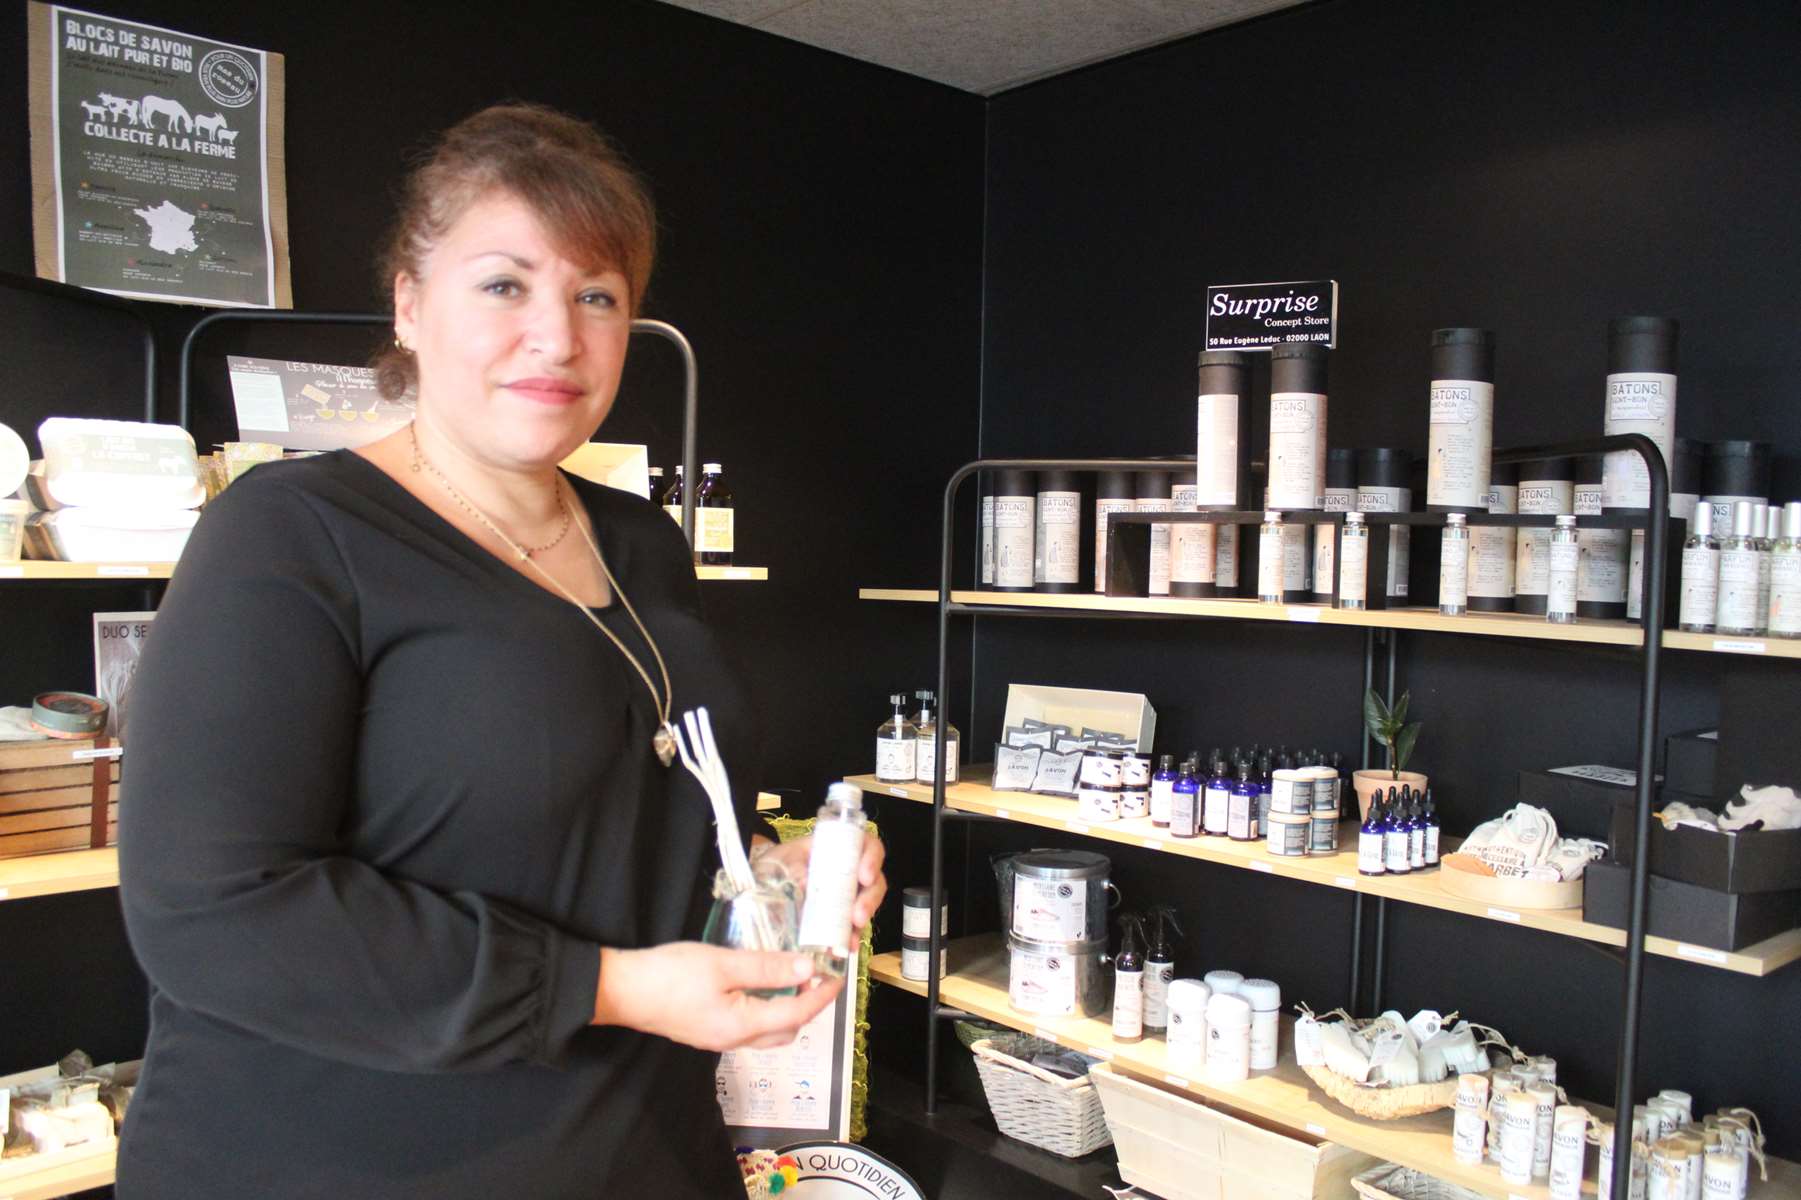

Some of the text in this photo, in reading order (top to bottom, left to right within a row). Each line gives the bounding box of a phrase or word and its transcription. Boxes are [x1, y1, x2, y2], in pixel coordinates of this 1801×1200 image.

[66, 20, 193, 59] BLOCS DE SAVON
[66, 36, 87, 52] AU
[90, 41, 121, 58] LAIT
[124, 48, 150, 64] PUR
[152, 54, 169, 68] ET
[171, 57, 193, 73] BIO
[84, 121, 154, 146] COLLECTE
[157, 134, 169, 148] A
[172, 137, 192, 153] LA
[194, 141, 237, 159] FERME
[1210, 290, 1319, 320] Surprise
[1264, 315, 1330, 328] Concept Store
[1220, 337, 1233, 345] Rue
[1286, 334, 1309, 342] 02000
[1310, 333, 1330, 341] LAON
[286, 361, 310, 374] LES
[311, 362, 377, 380] MASQUES
[103, 625, 147, 639] DUO SE
[809, 1154, 906, 1200] QUOTIDIEN
